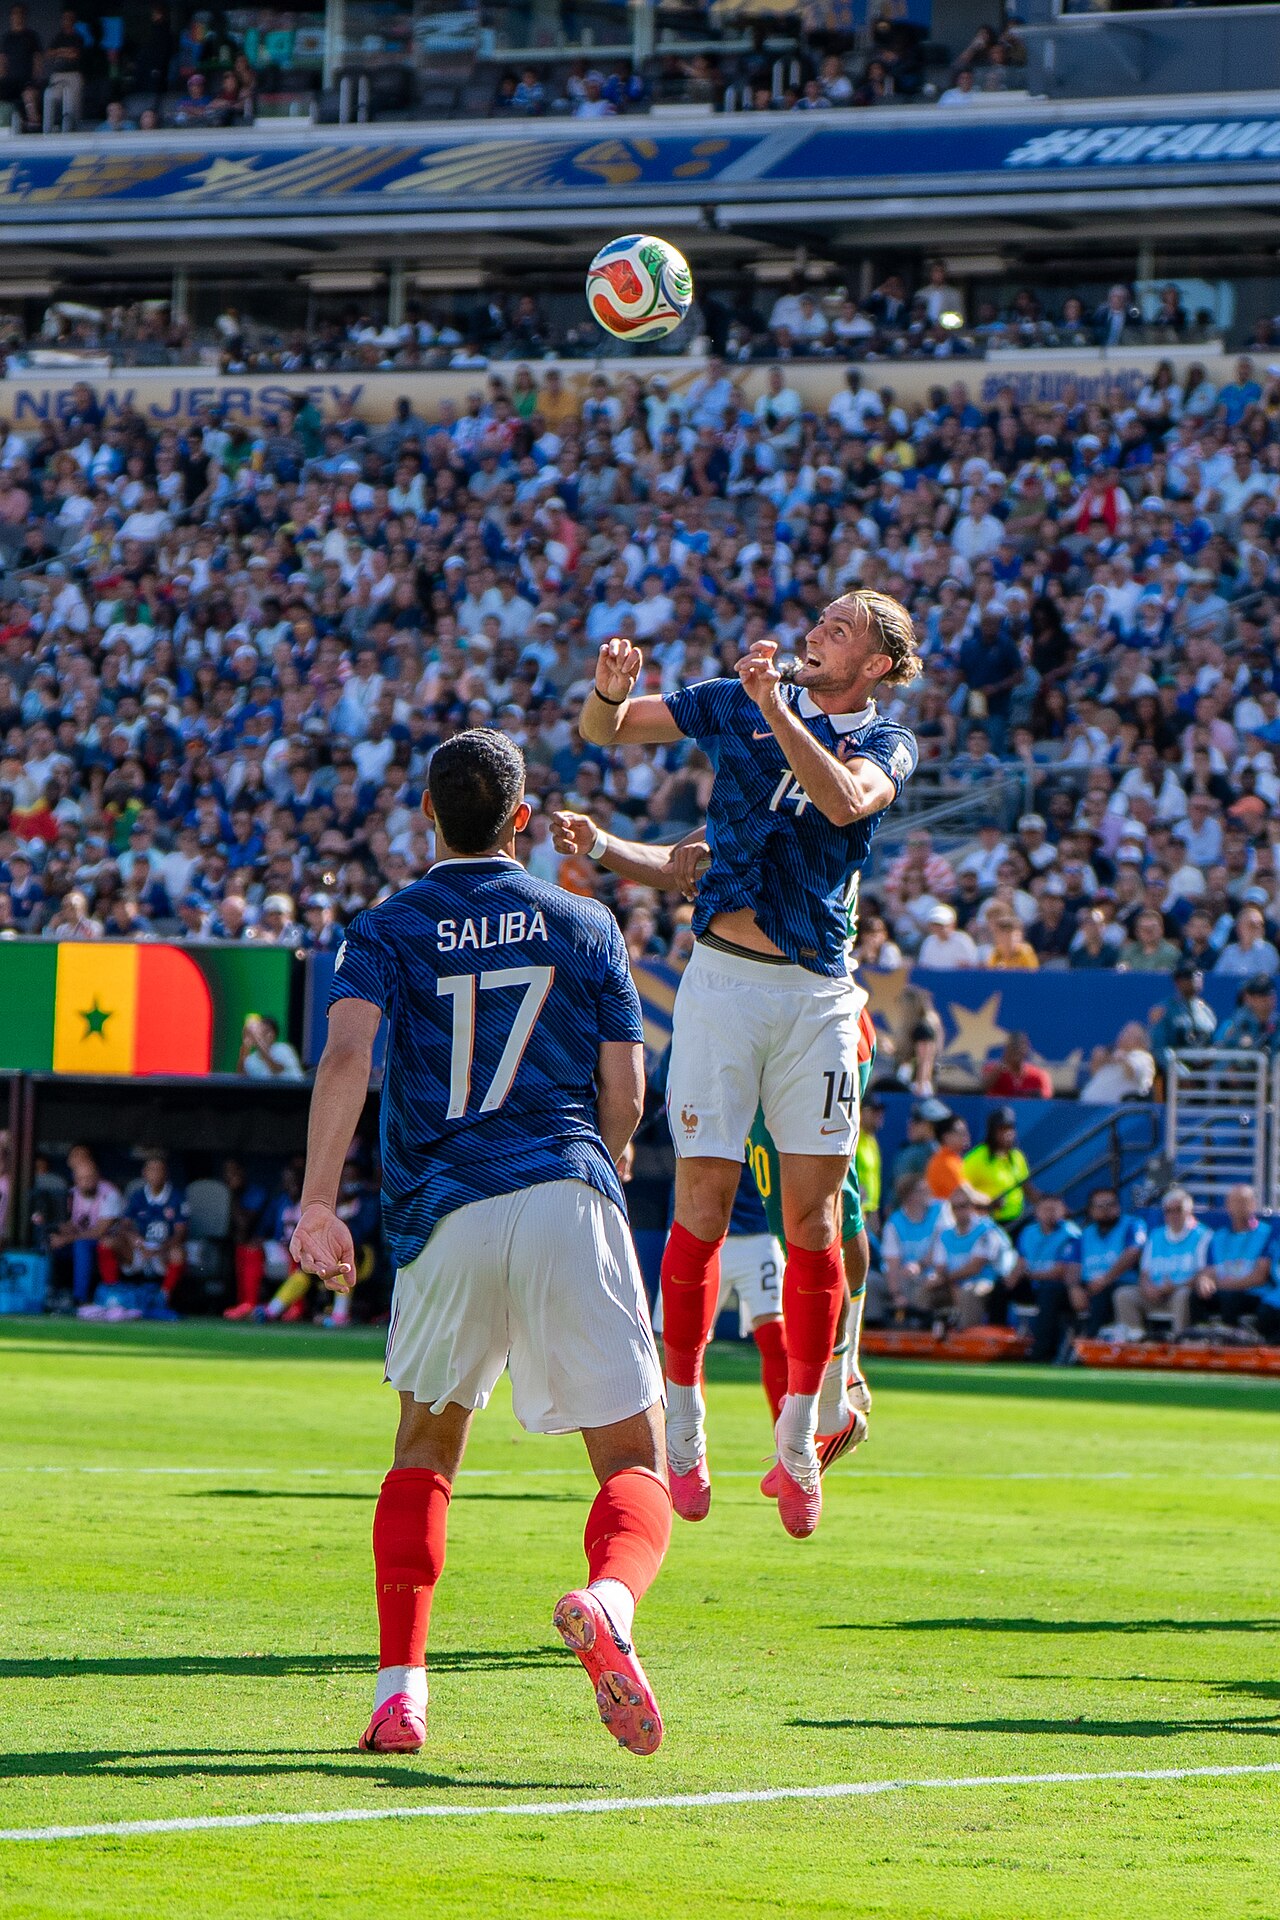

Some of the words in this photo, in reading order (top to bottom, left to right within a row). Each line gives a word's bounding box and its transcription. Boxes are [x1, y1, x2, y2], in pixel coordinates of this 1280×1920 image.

[769, 768, 813, 816] 14
[437, 911, 548, 952] SALIBA
[437, 966, 555, 1120] 17
[823, 1070, 856, 1120] 14
